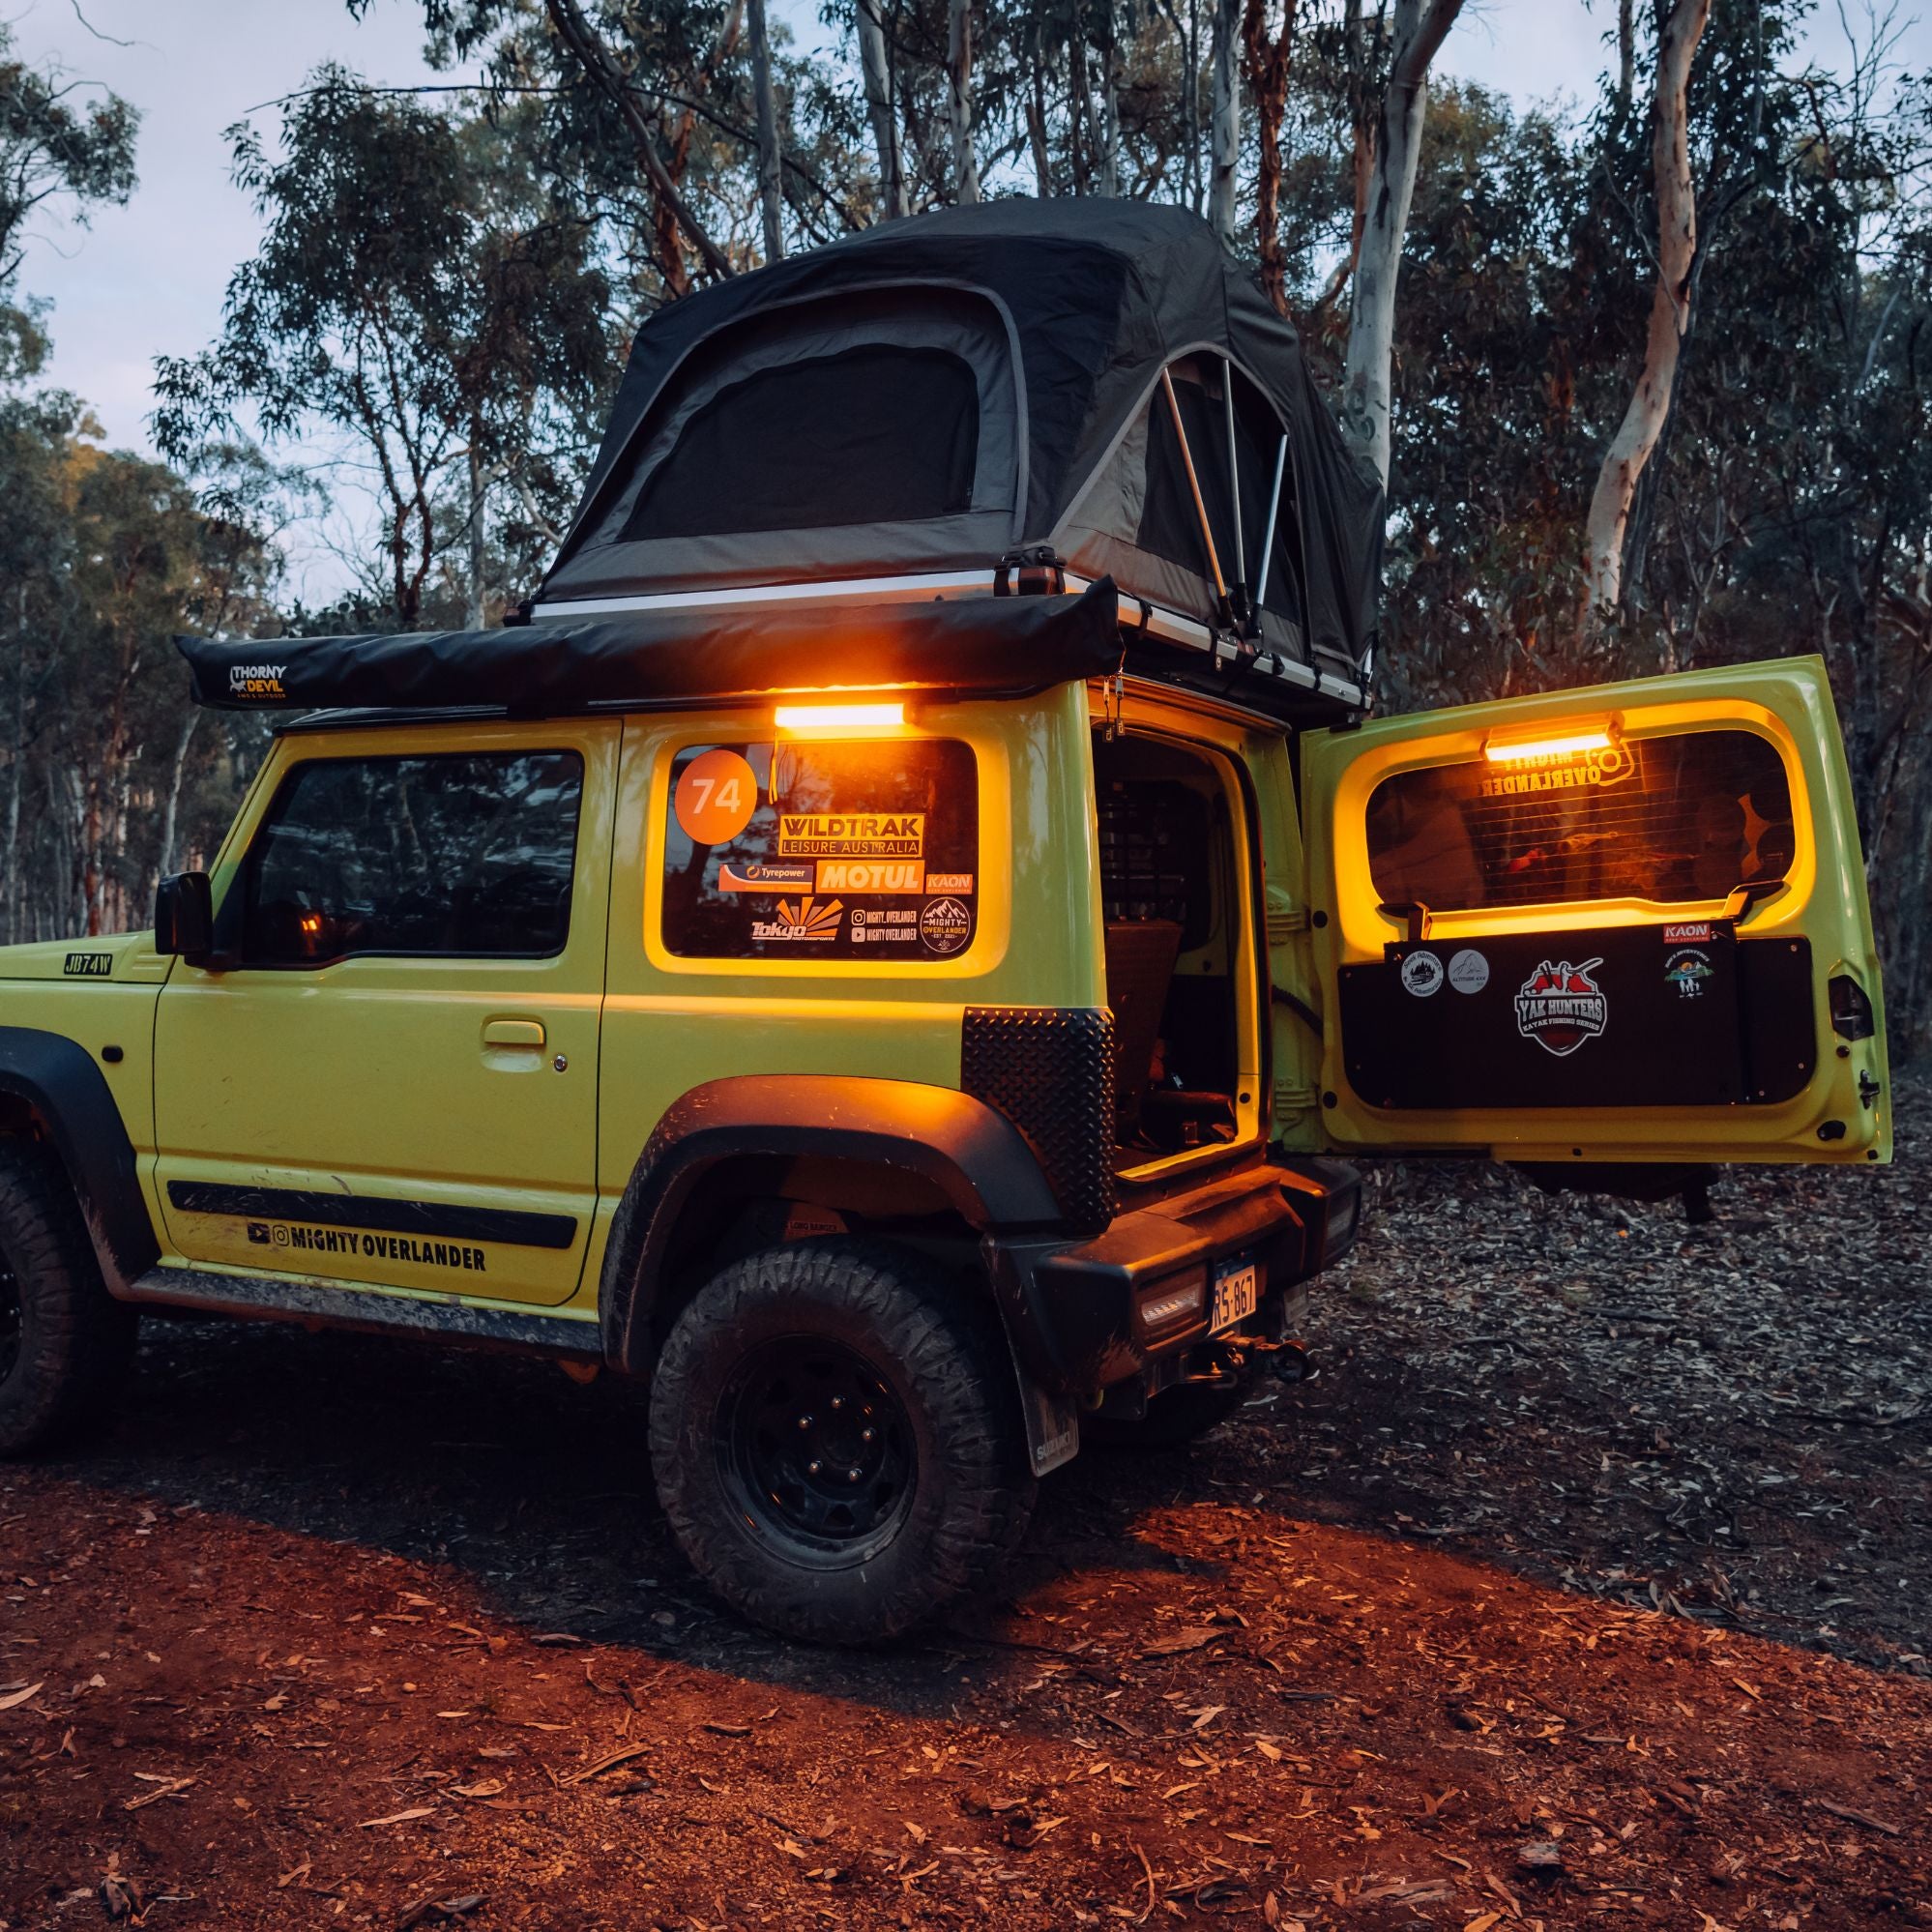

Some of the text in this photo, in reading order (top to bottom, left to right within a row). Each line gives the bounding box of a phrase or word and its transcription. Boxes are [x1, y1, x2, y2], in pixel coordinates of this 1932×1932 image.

[232, 664, 287, 680] THORNY
[247, 680, 283, 692] DEVIL
[692, 778, 741, 814] 74
[783, 818, 920, 836] WILDTRAK
[783, 840, 919, 853] LEISURE AUSTRALIA
[762, 867, 805, 878] Tyrepower
[820, 865, 919, 889] MOTUL
[927, 875, 971, 888] KAON
[928, 918, 961, 926] MIGHTY
[751, 922, 807, 940] Tokyo
[866, 928, 917, 941] MIGHTY OVERLANDER
[1665, 924, 1708, 937] KAON
[66, 954, 111, 973] JB74W
[1519, 998, 1603, 1022] YAK HUNTERS
[1522, 1018, 1548, 1032] KAYAK
[1575, 1018, 1600, 1031] SERIES
[291, 1226, 485, 1272] MIGHTY OVERLANDER
